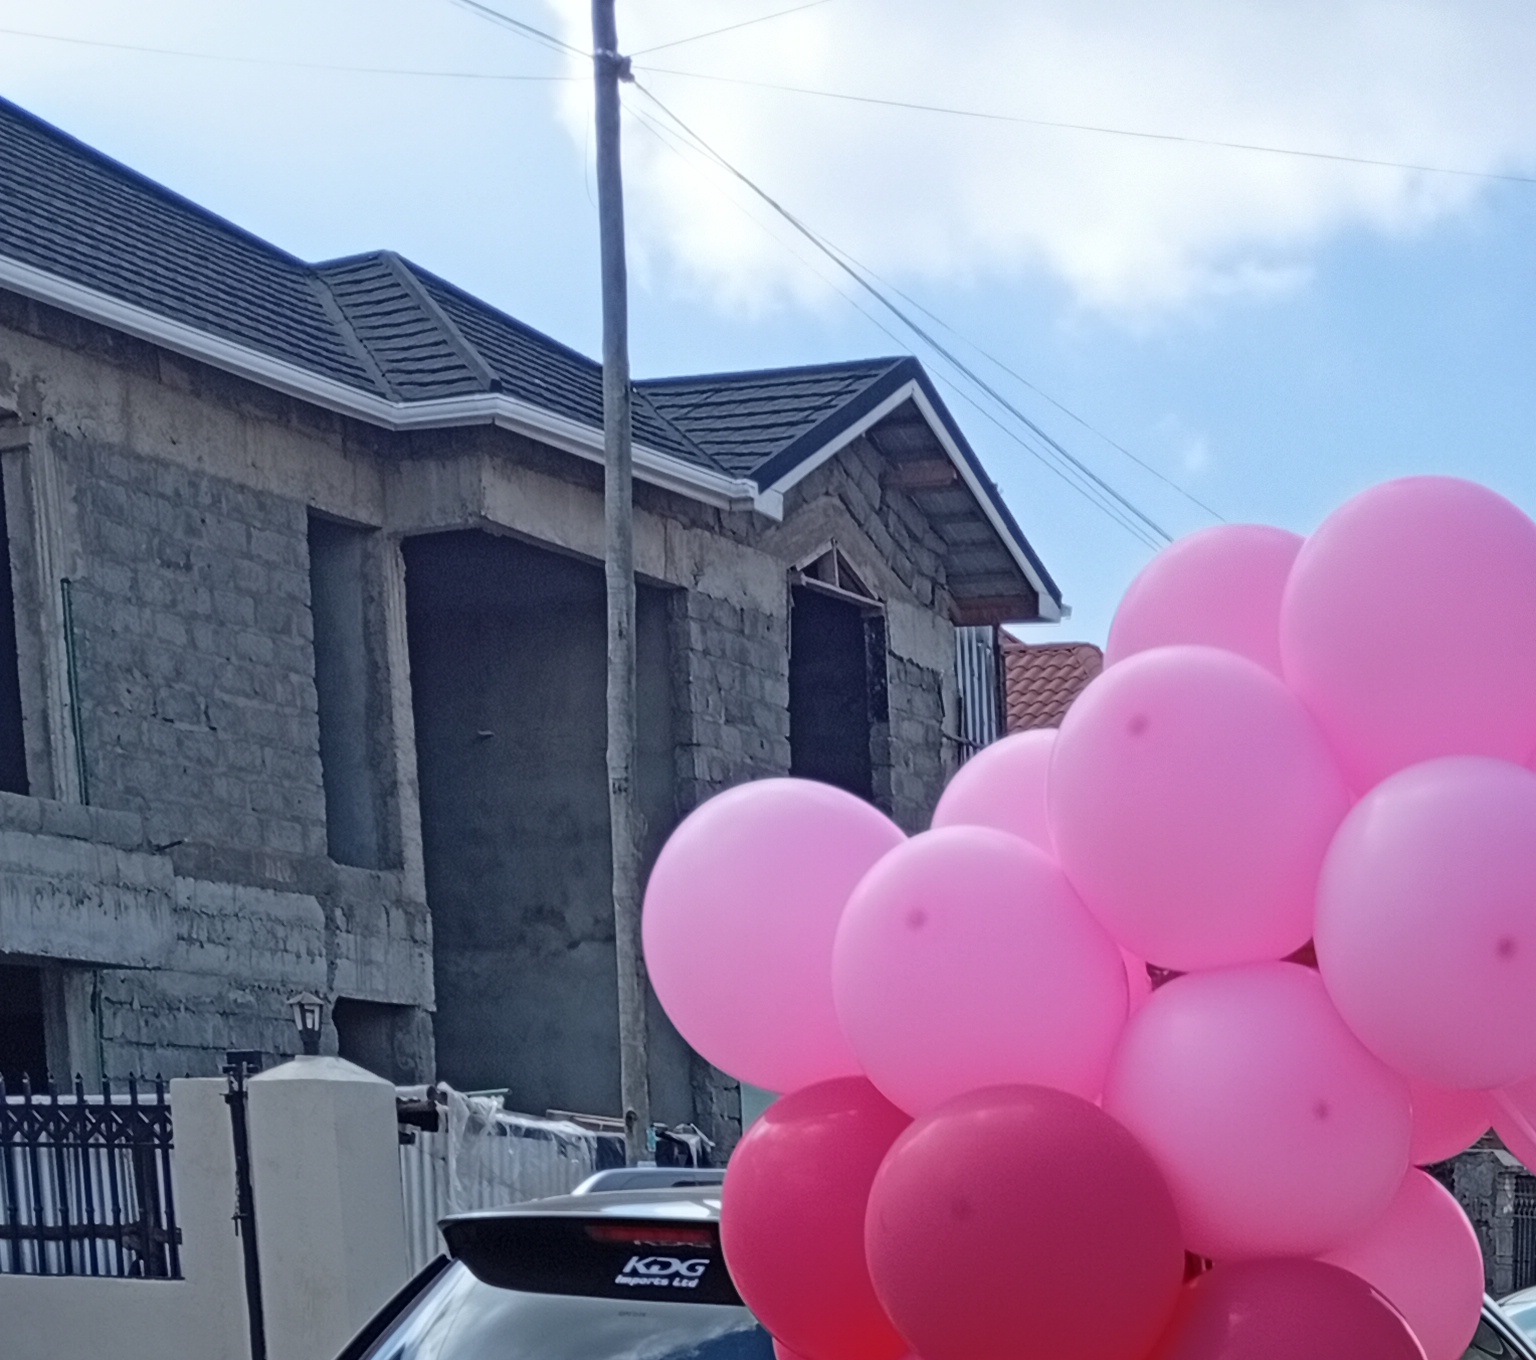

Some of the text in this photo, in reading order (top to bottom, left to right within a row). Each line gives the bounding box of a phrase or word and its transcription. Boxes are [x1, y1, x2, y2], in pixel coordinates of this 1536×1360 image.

[622, 1256, 710, 1276] KDG
[615, 1274, 699, 1288] Imports Ltd
